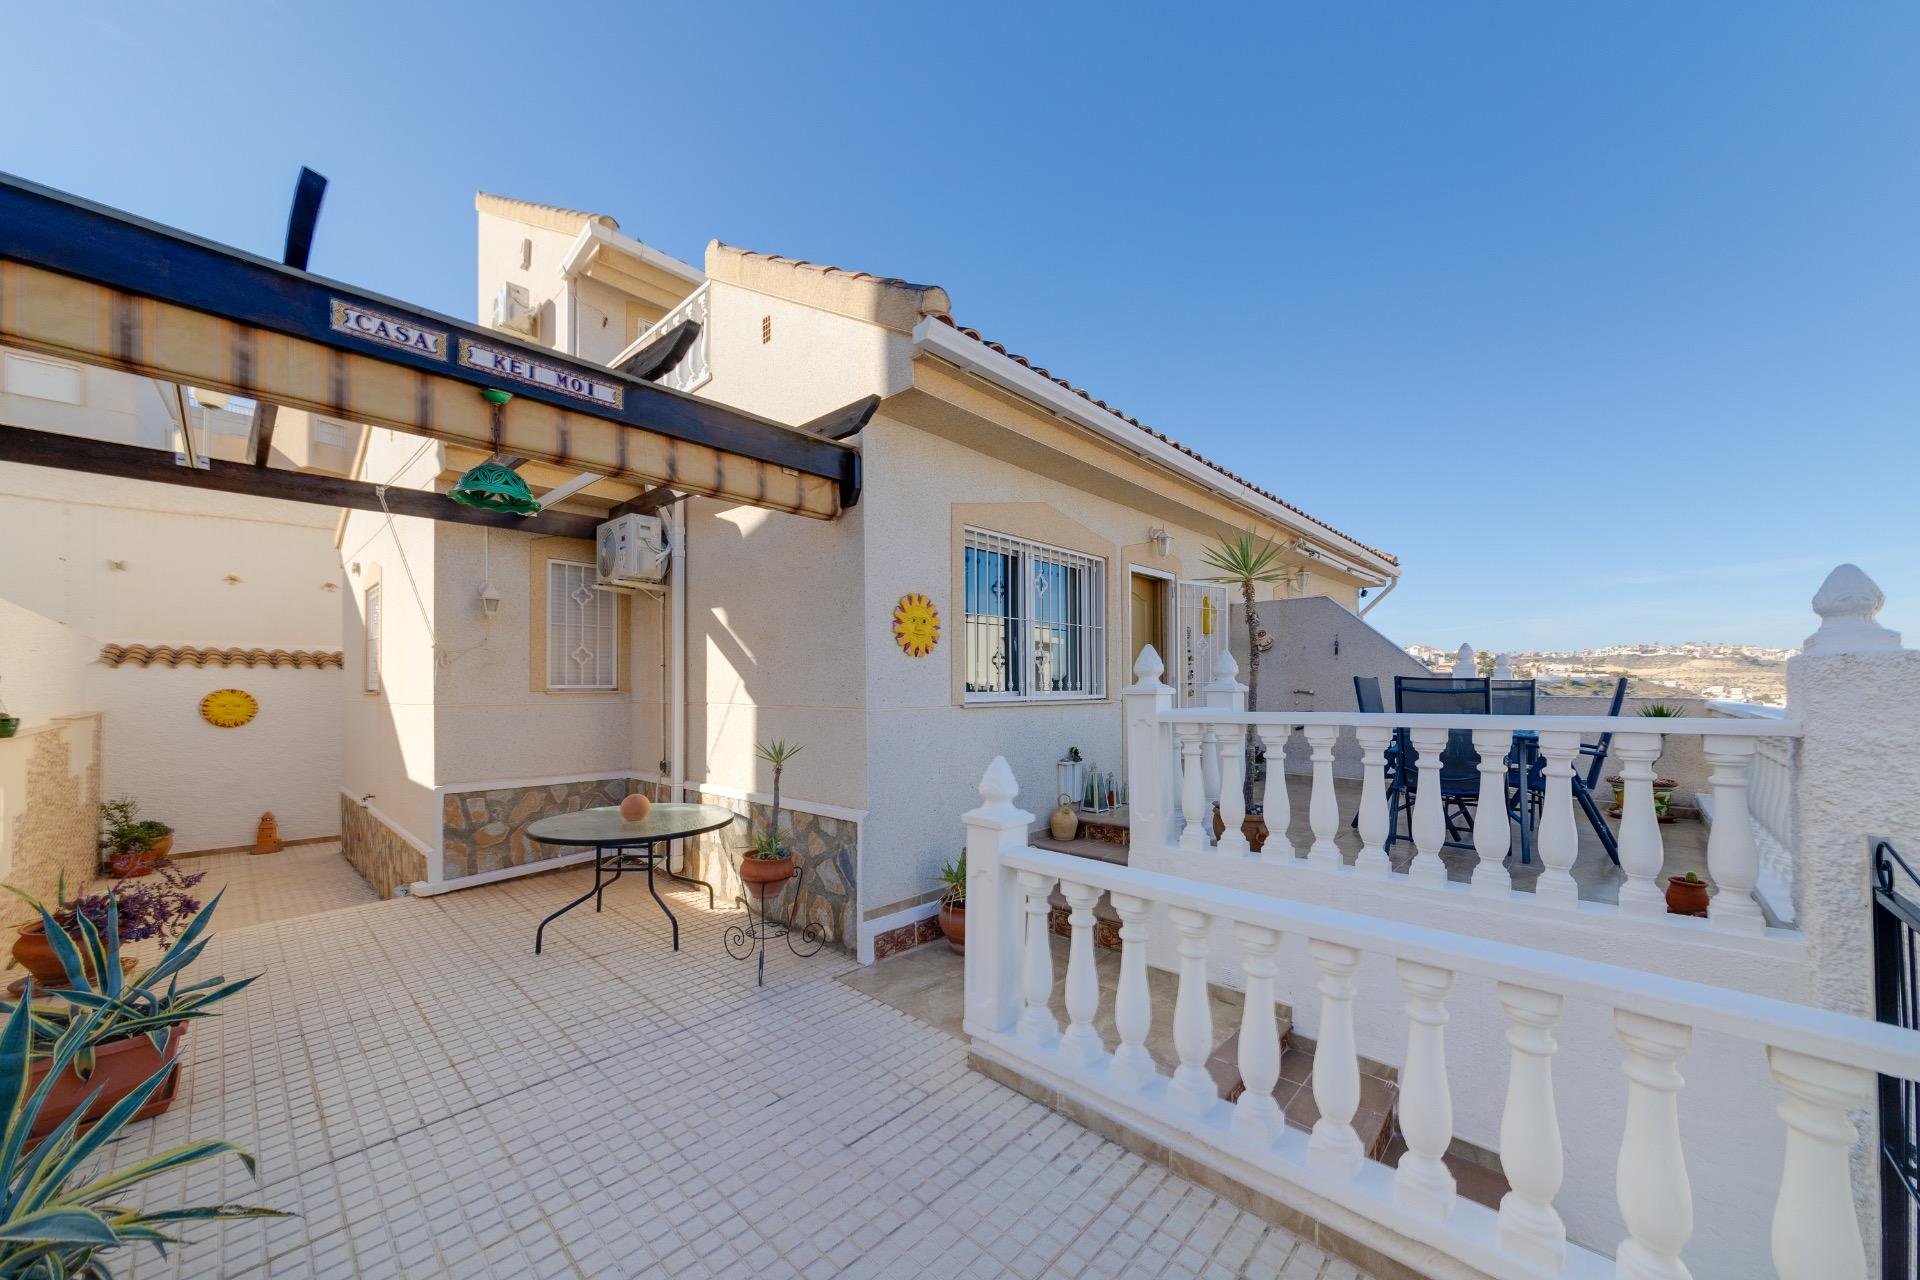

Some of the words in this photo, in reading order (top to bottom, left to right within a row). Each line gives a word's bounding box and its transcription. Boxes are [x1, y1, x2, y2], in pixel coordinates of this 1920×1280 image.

[355, 313, 430, 350] CASA
[493, 355, 535, 380] KEI
[556, 374, 596, 397] MOI
